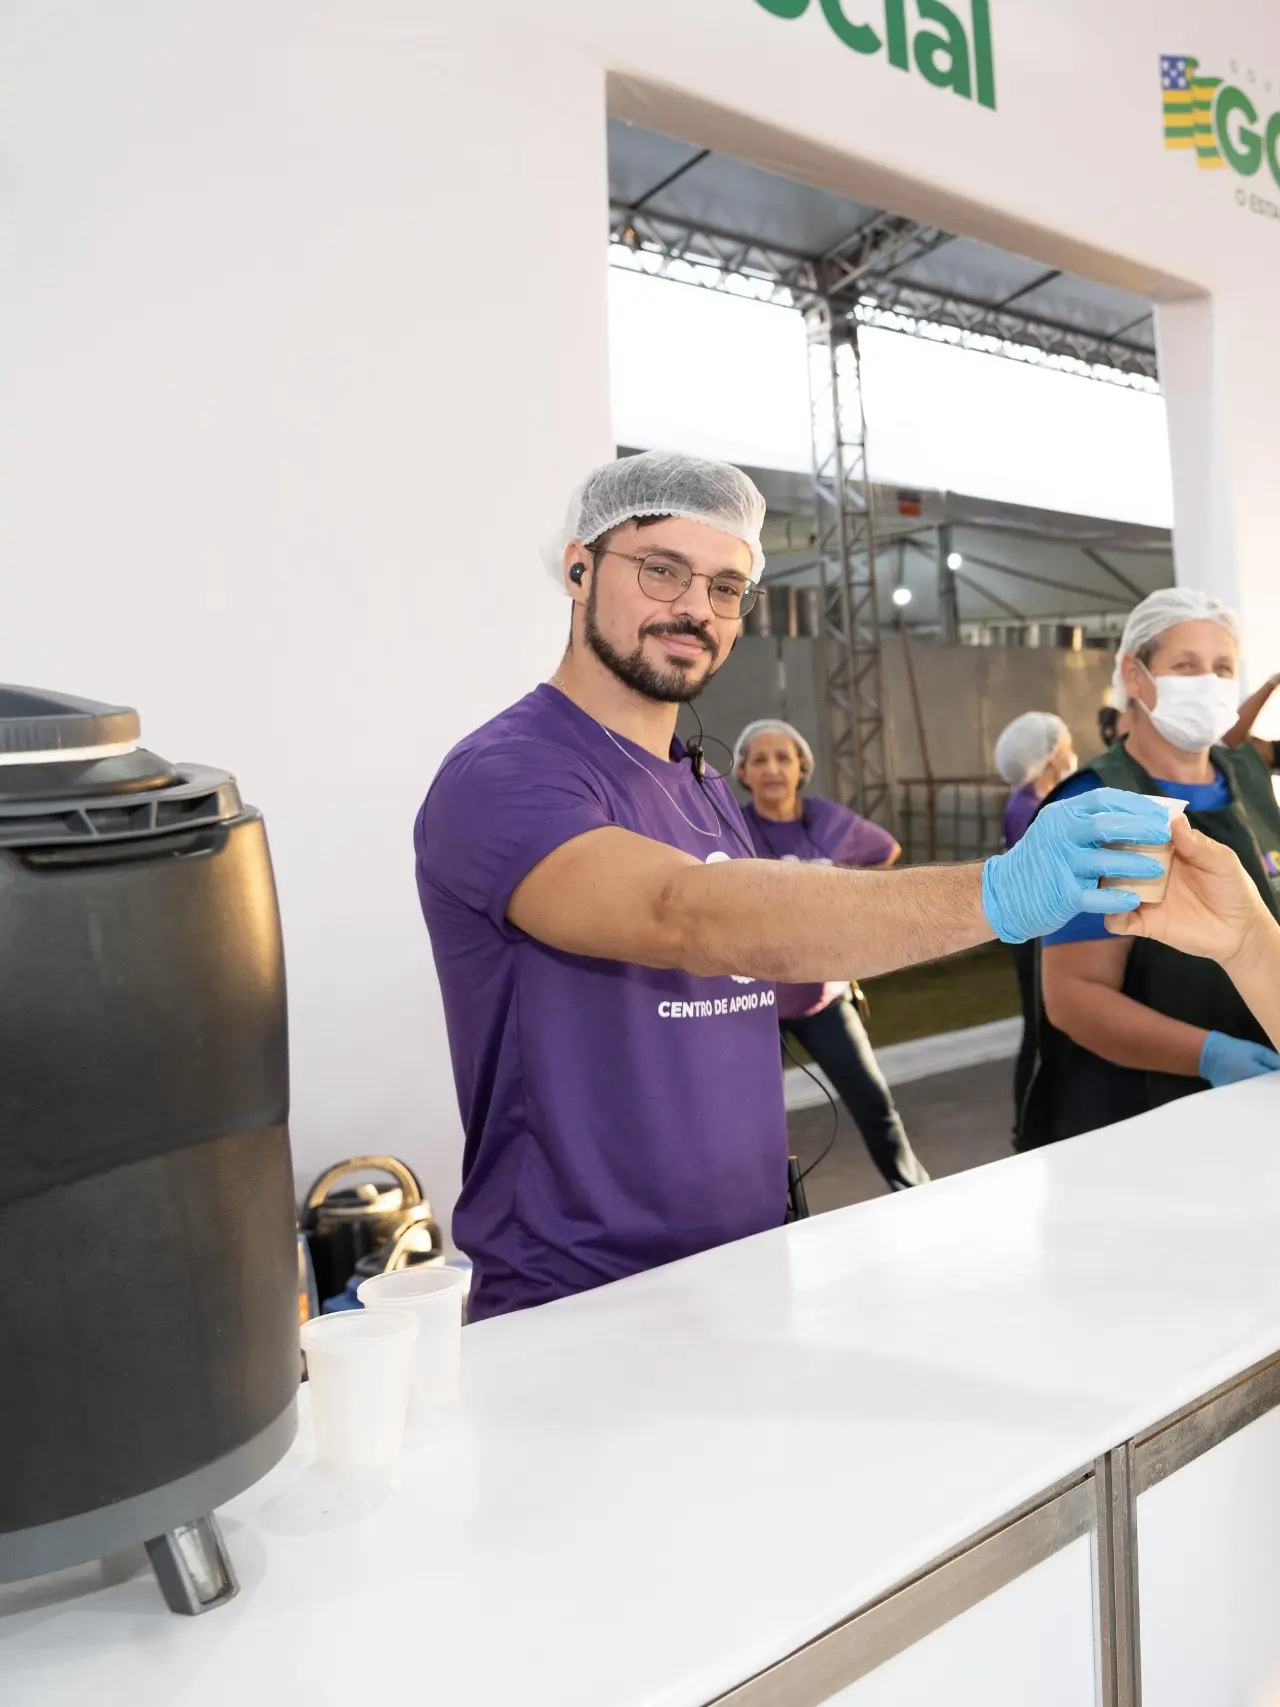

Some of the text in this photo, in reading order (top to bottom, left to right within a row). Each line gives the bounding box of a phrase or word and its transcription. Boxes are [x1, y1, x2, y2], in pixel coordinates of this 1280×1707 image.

[754, 0, 997, 112] cial
[1234, 187, 1248, 207] O
[658, 990, 775, 1018] CENTRO DE APOIO AO
